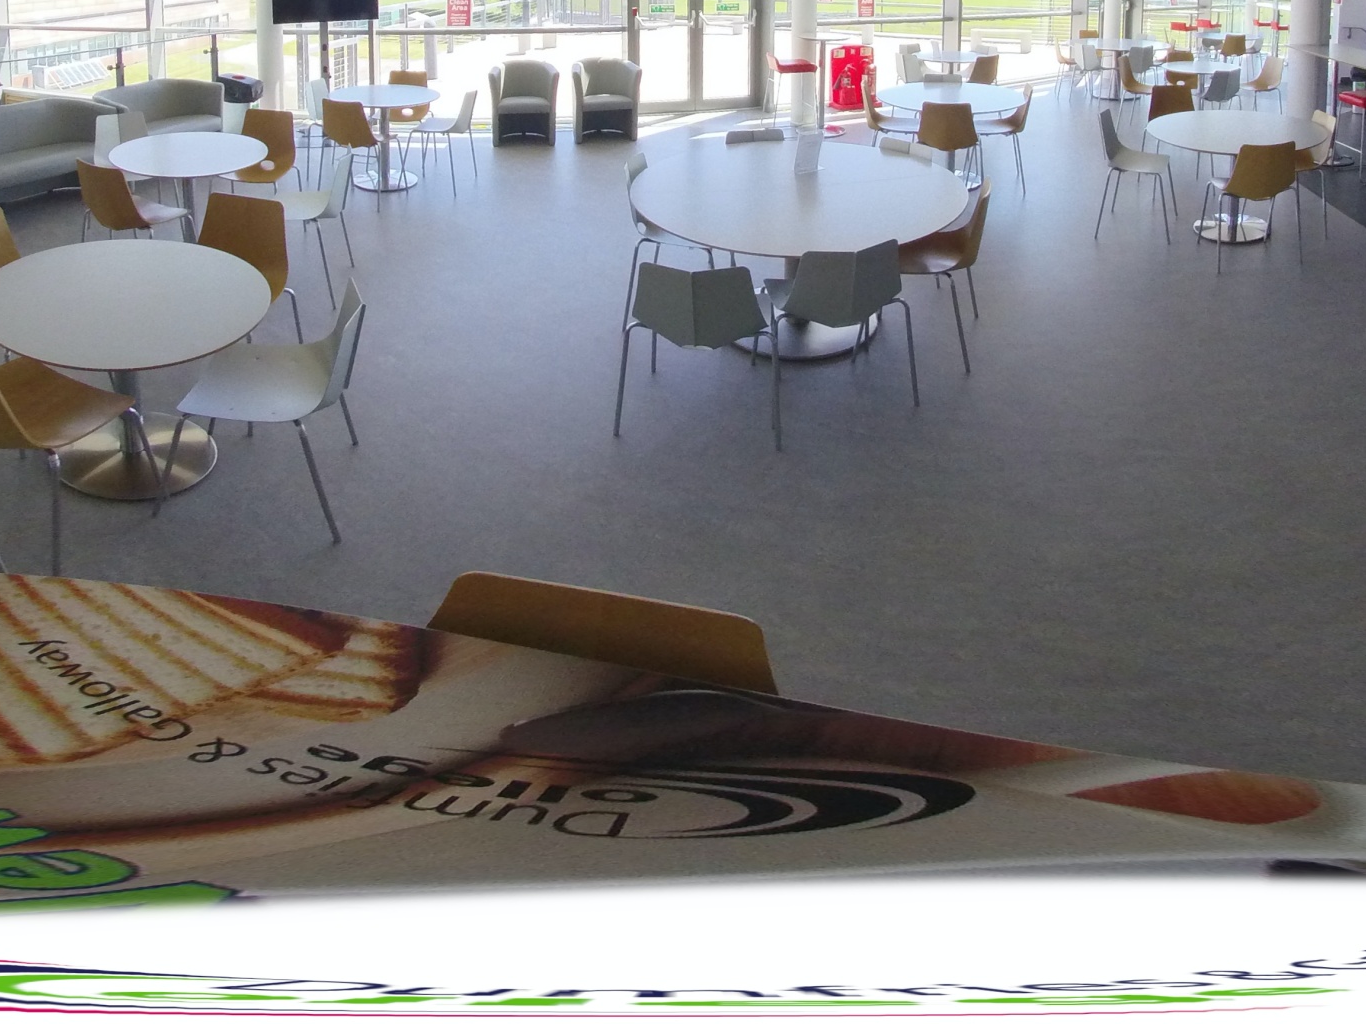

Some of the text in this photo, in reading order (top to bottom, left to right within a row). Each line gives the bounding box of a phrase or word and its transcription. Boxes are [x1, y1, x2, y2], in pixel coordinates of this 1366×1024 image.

[18, 639, 631, 838] Dumfries & Galloway
